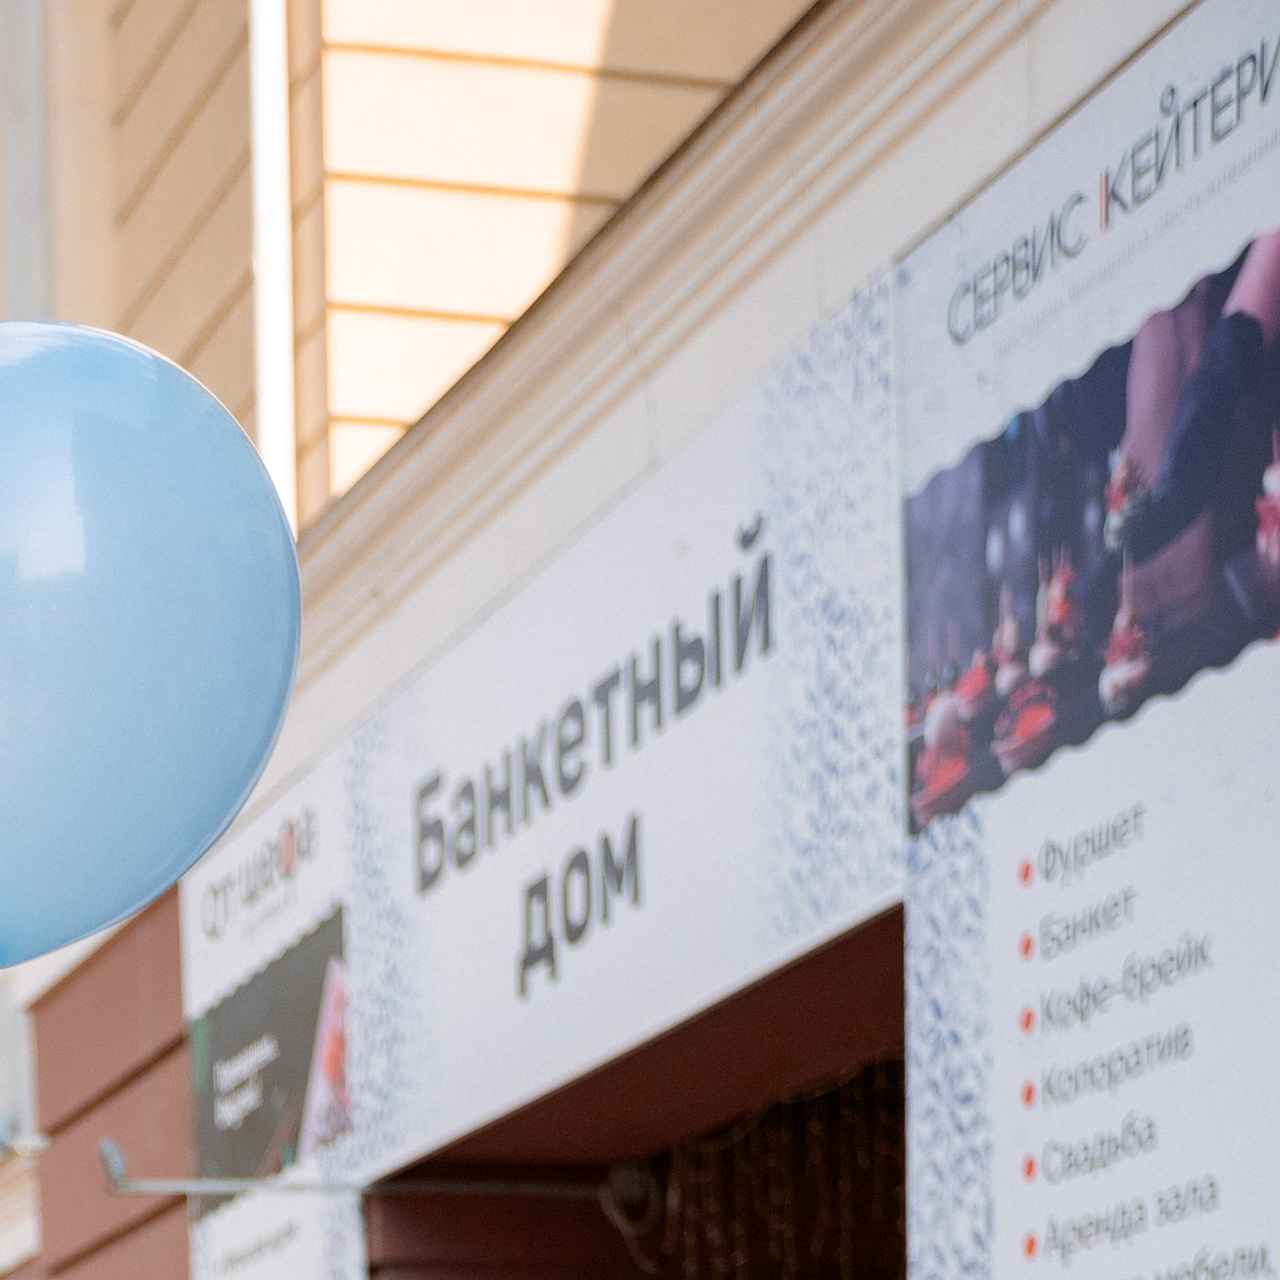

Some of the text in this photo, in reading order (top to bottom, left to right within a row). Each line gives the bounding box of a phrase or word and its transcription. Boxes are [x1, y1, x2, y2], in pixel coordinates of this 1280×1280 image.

[948, 192, 1089, 346] СЕРВИС
[413, 512, 774, 896] Банкетный
[1038, 803, 1145, 886] Фуршет
[517, 809, 642, 999] дом
[1039, 886, 1137, 960] Банкет
[1041, 931, 1212, 1036] Кофе-брейк
[1042, 1109, 1157, 1184] Свадьба
[1042, 1174, 1219, 1268] Аренда зала
